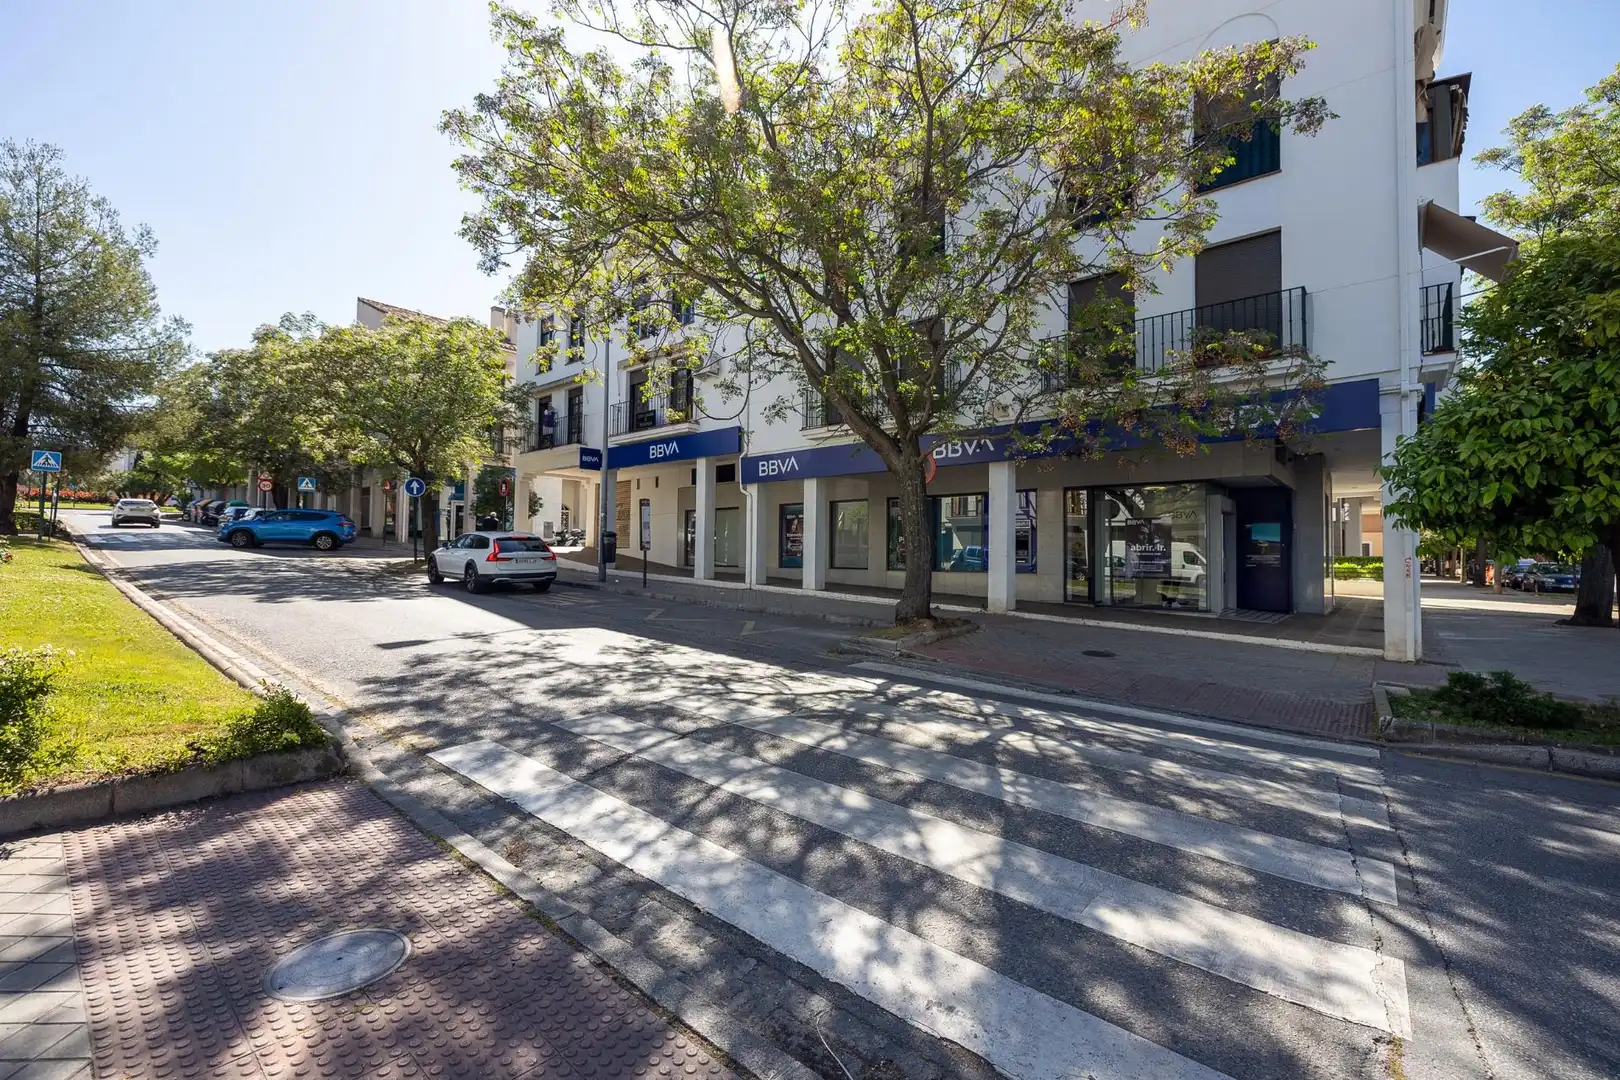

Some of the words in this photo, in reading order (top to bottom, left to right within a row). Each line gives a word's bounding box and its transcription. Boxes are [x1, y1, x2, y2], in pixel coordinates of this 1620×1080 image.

[649, 440, 679, 459] BBVA
[582, 454, 599, 463] BBVA
[758, 455, 799, 477] BBVA
[1130, 543, 1155, 552] abrir.
